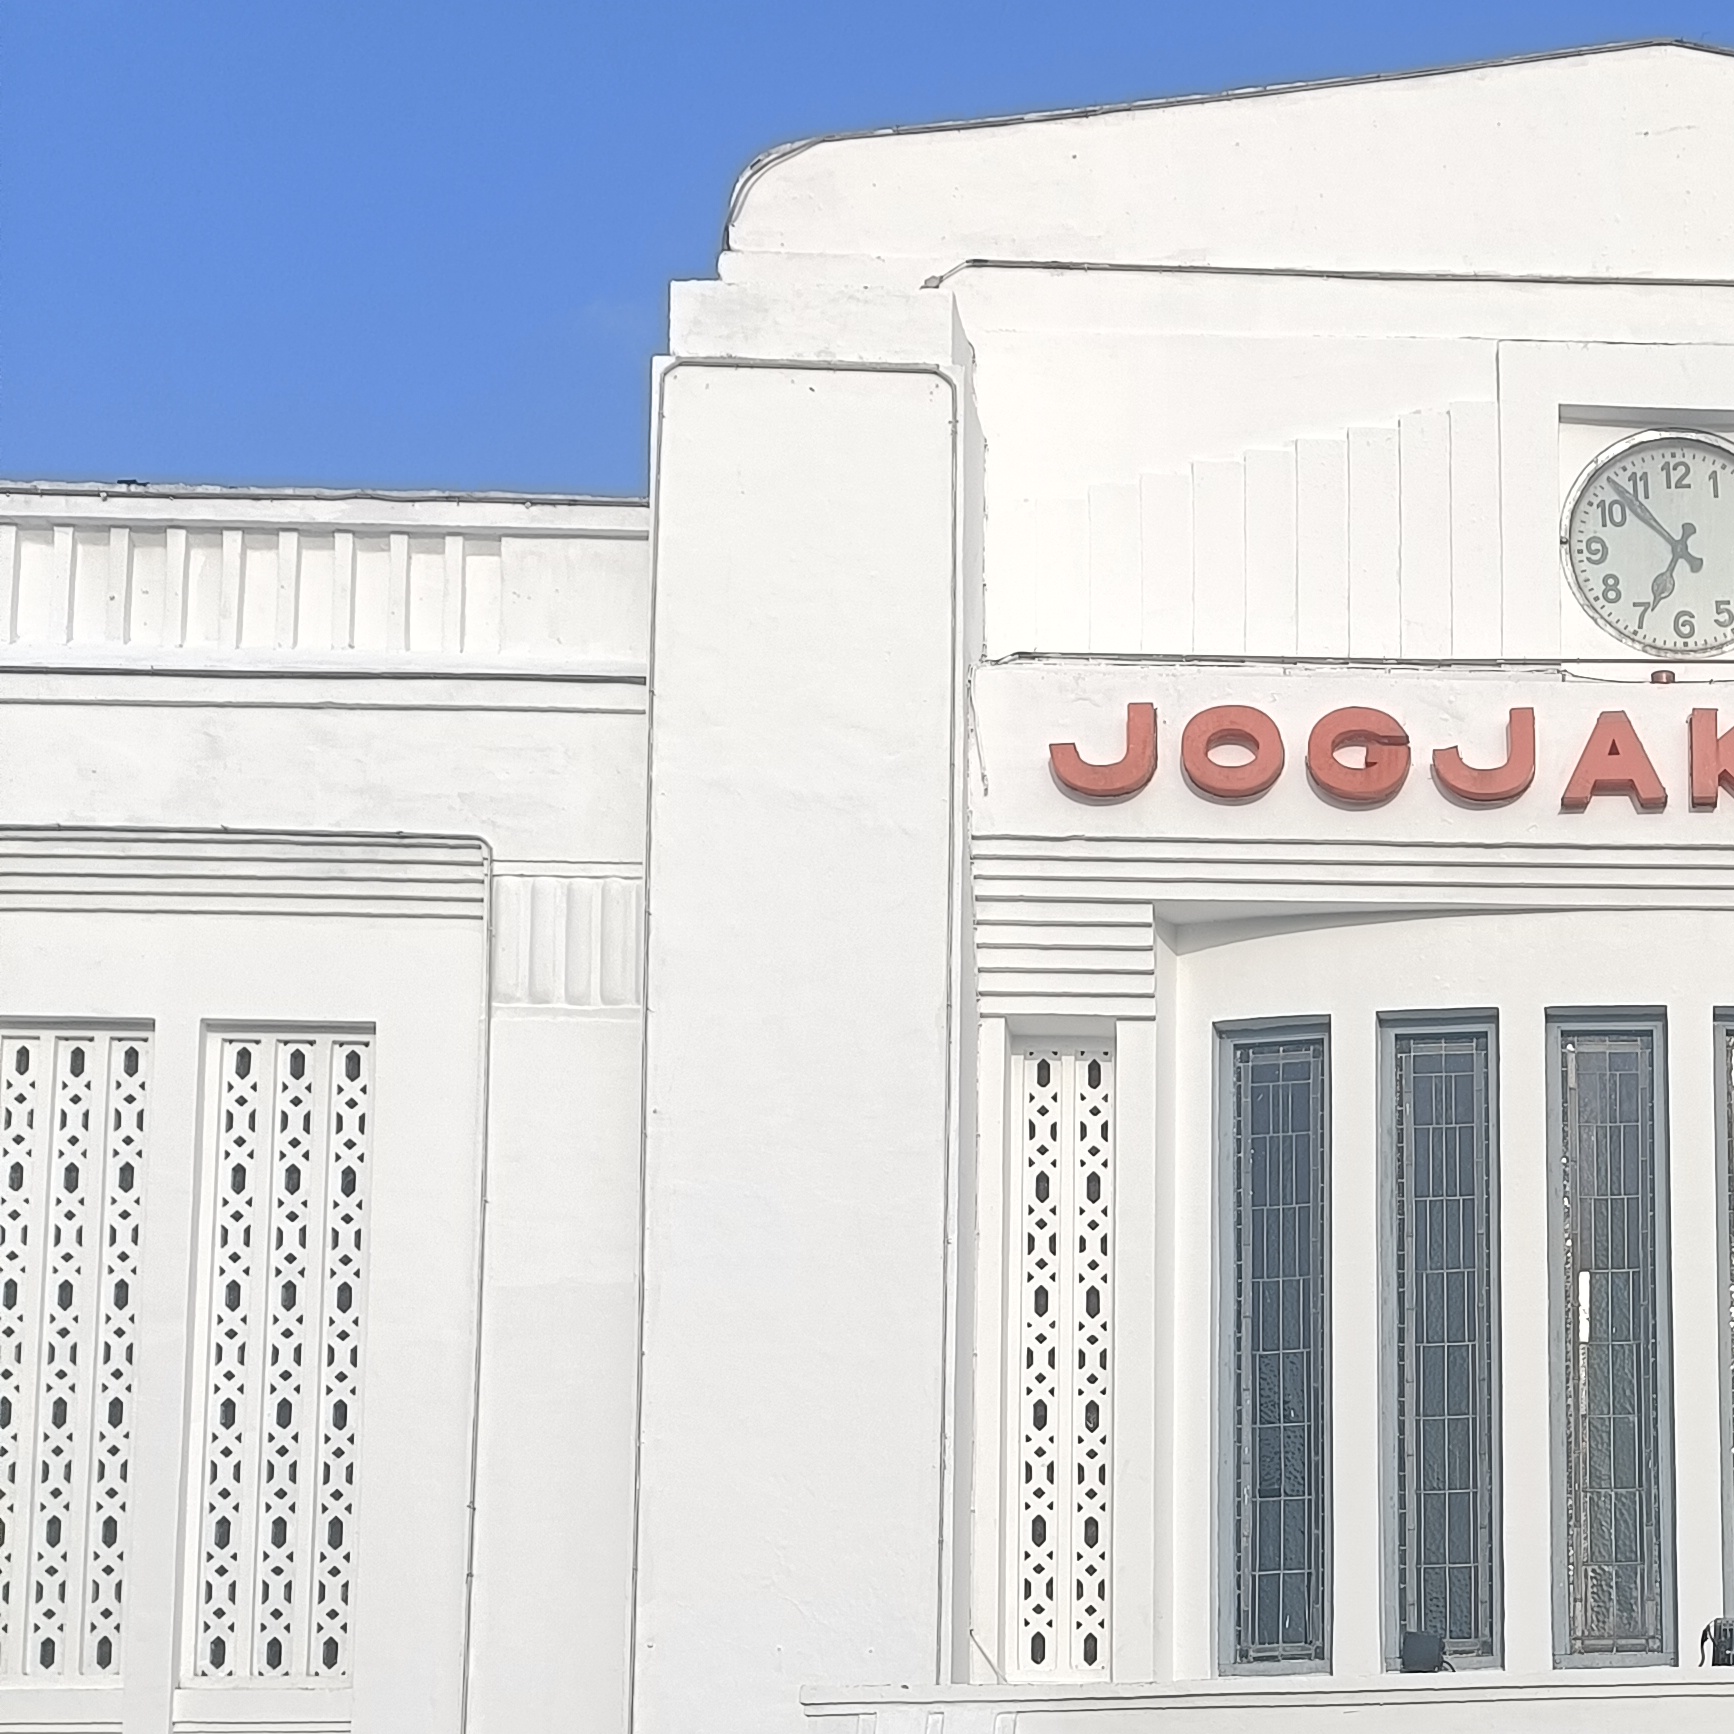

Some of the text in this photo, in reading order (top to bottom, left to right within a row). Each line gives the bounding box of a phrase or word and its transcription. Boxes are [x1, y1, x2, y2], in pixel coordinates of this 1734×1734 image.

[1627, 471, 1650, 499] 11
[1660, 461, 1692, 489] 12
[1708, 470, 1719, 498] 1
[1596, 499, 1627, 527] 10
[1585, 536, 1608, 565] 9
[1601, 573, 1621, 603] 8
[1632, 601, 1651, 629] 7
[1673, 610, 1695, 638] 6
[1713, 600, 1734, 628] 5
